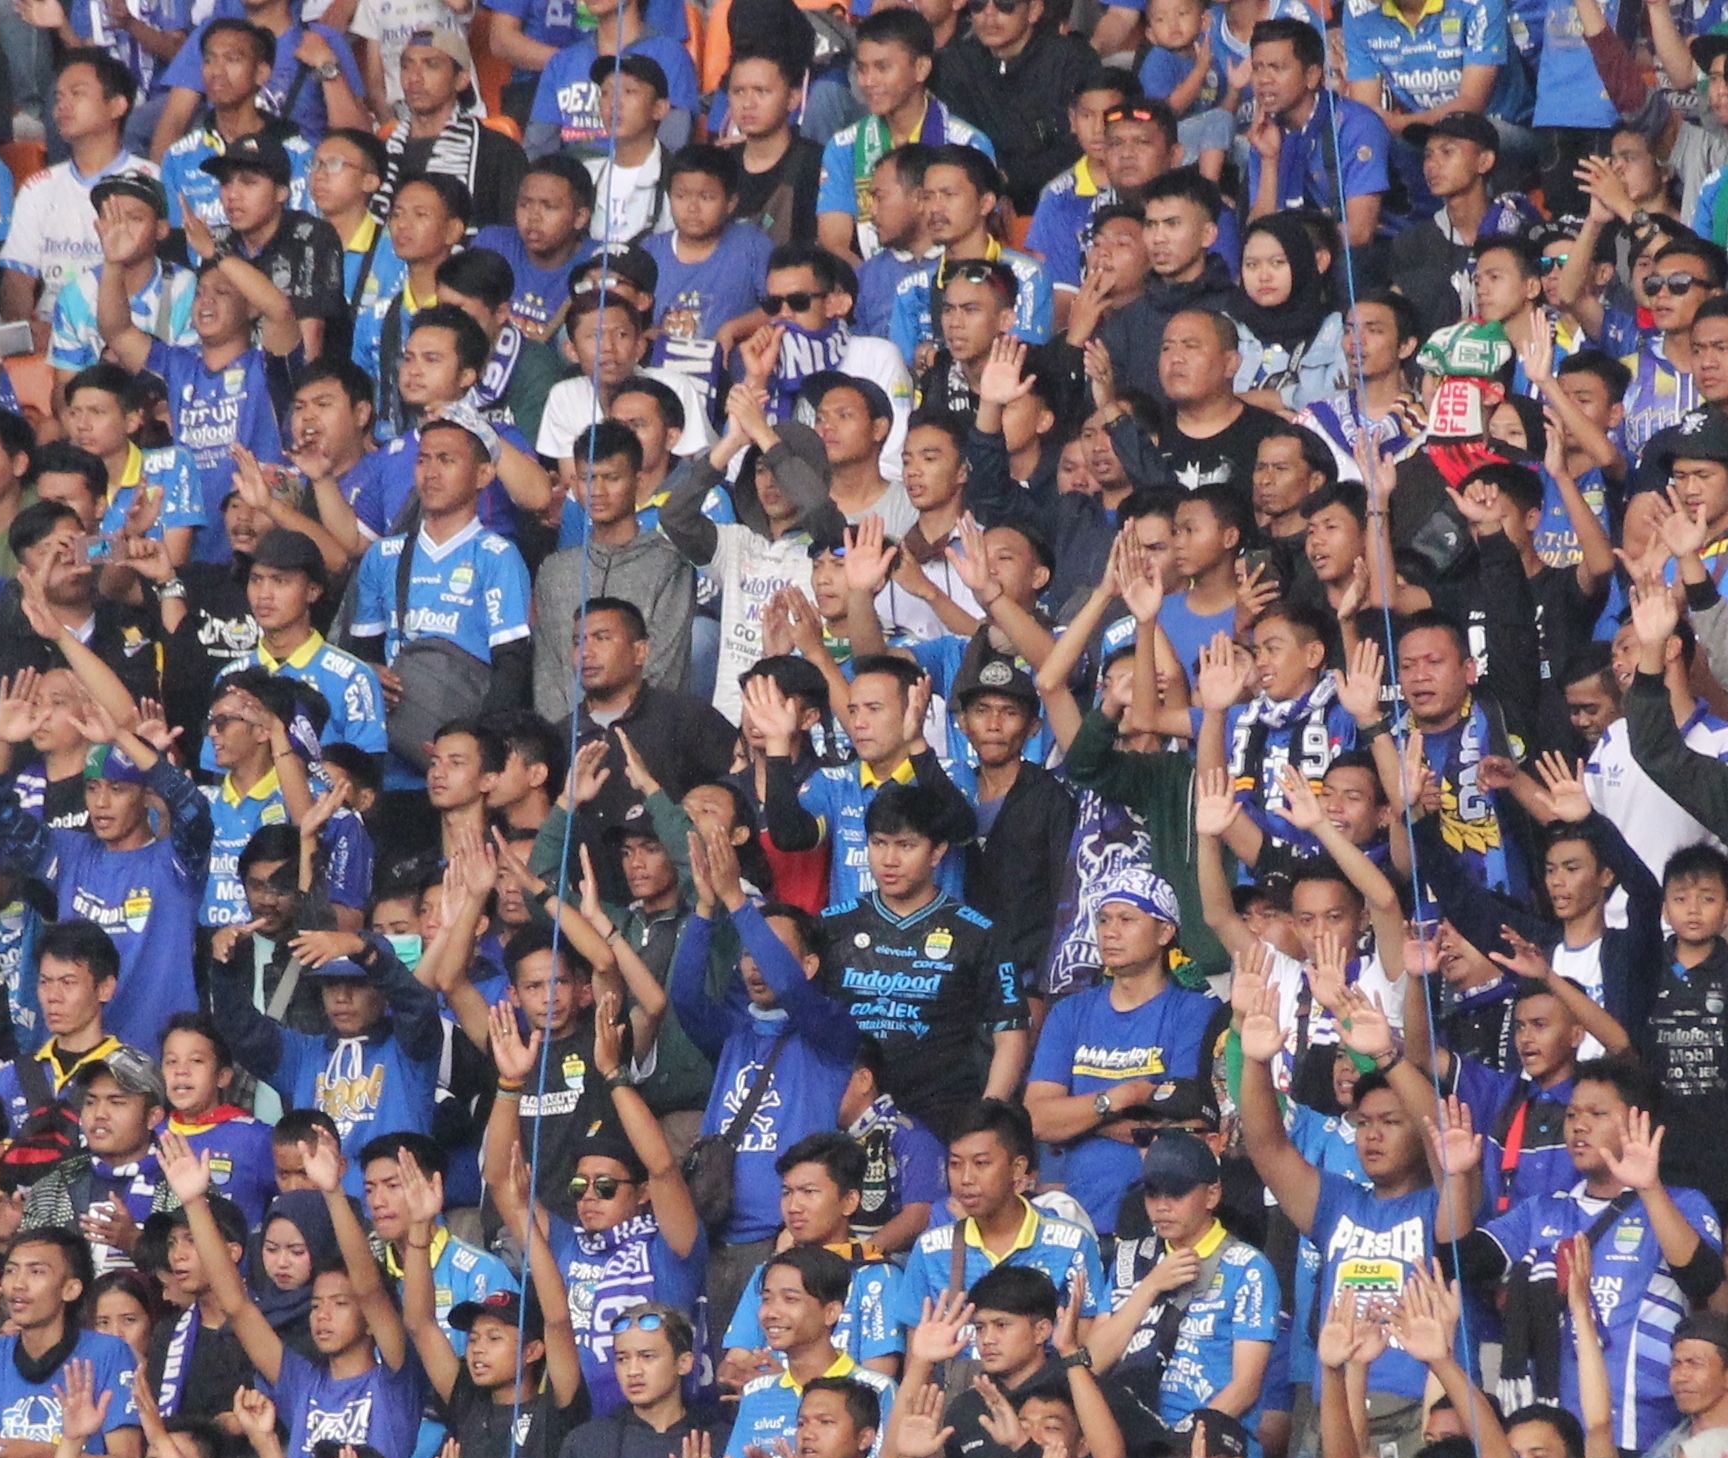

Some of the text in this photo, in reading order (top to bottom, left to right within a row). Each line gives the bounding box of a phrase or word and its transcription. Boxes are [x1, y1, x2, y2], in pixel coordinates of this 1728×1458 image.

[1394, 66, 1462, 94] Indofoo
[841, 965, 942, 1002] Indofood
[1327, 1215, 1426, 1263] PERSIB
